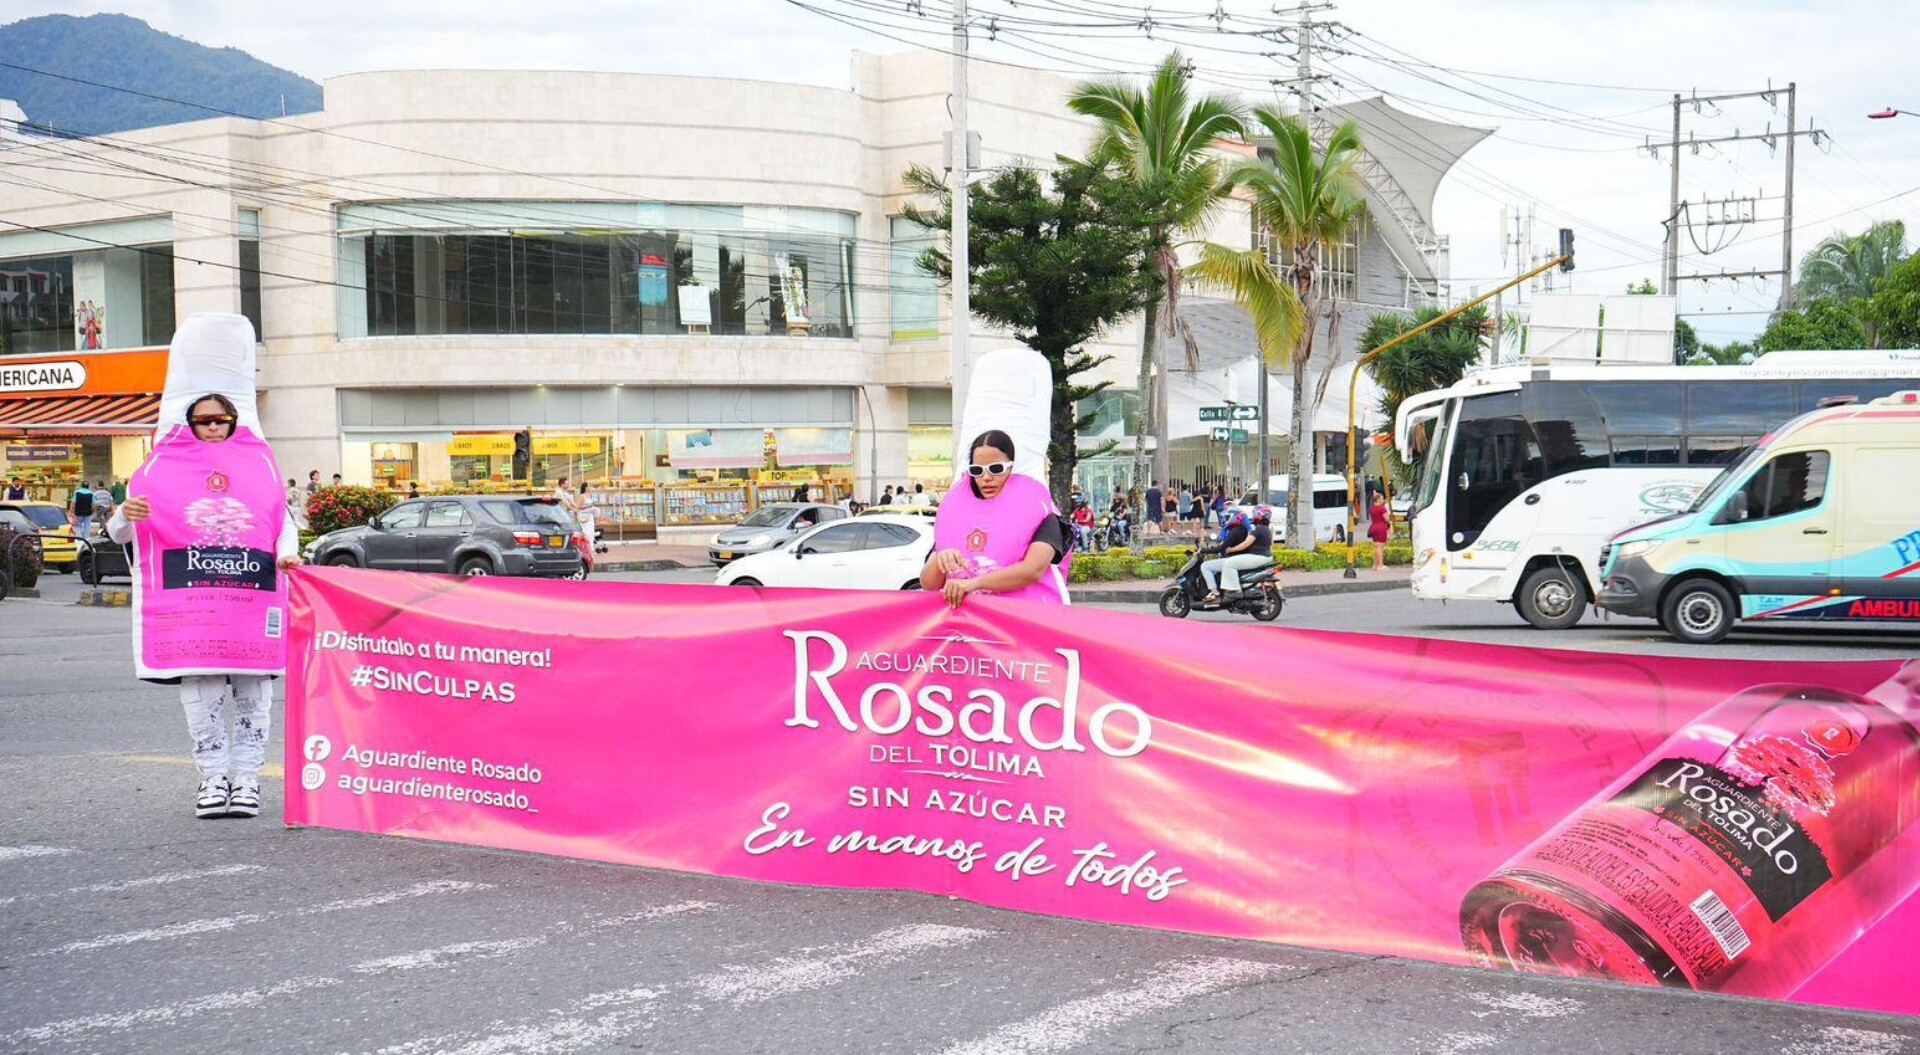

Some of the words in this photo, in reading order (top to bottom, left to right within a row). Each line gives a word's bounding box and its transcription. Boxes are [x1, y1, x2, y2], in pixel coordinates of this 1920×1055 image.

[771, 472, 787, 480] TOP
[187, 550, 261, 572] Rosado
[315, 630, 415, 658] ¡Disfrutalo
[417, 643, 431, 659] a
[434, 641, 455, 661] tu
[460, 646, 552, 668] manera!
[855, 651, 1053, 684] AGUARDIENTE
[782, 629, 1153, 758] Rosado
[342, 745, 467, 775] Aguardiente
[472, 758, 542, 783] Rosado
[869, 745, 923, 764] DEL
[928, 743, 1045, 778] TOLIMA
[337, 774, 540, 813] aguardienterosado_
[848, 786, 911, 808] SIN
[925, 790, 1067, 829] AZÚCAR
[1702, 776, 1782, 830] AGUARDIENTE
[1656, 762, 1798, 875] Rosado
[1683, 799, 1704, 814] DEL
[1707, 811, 1753, 850] TOLIMA
[743, 802, 815, 856] En
[826, 829, 988, 873] manos
[993, 838, 1057, 881] de
[1066, 843, 1188, 902] todos
